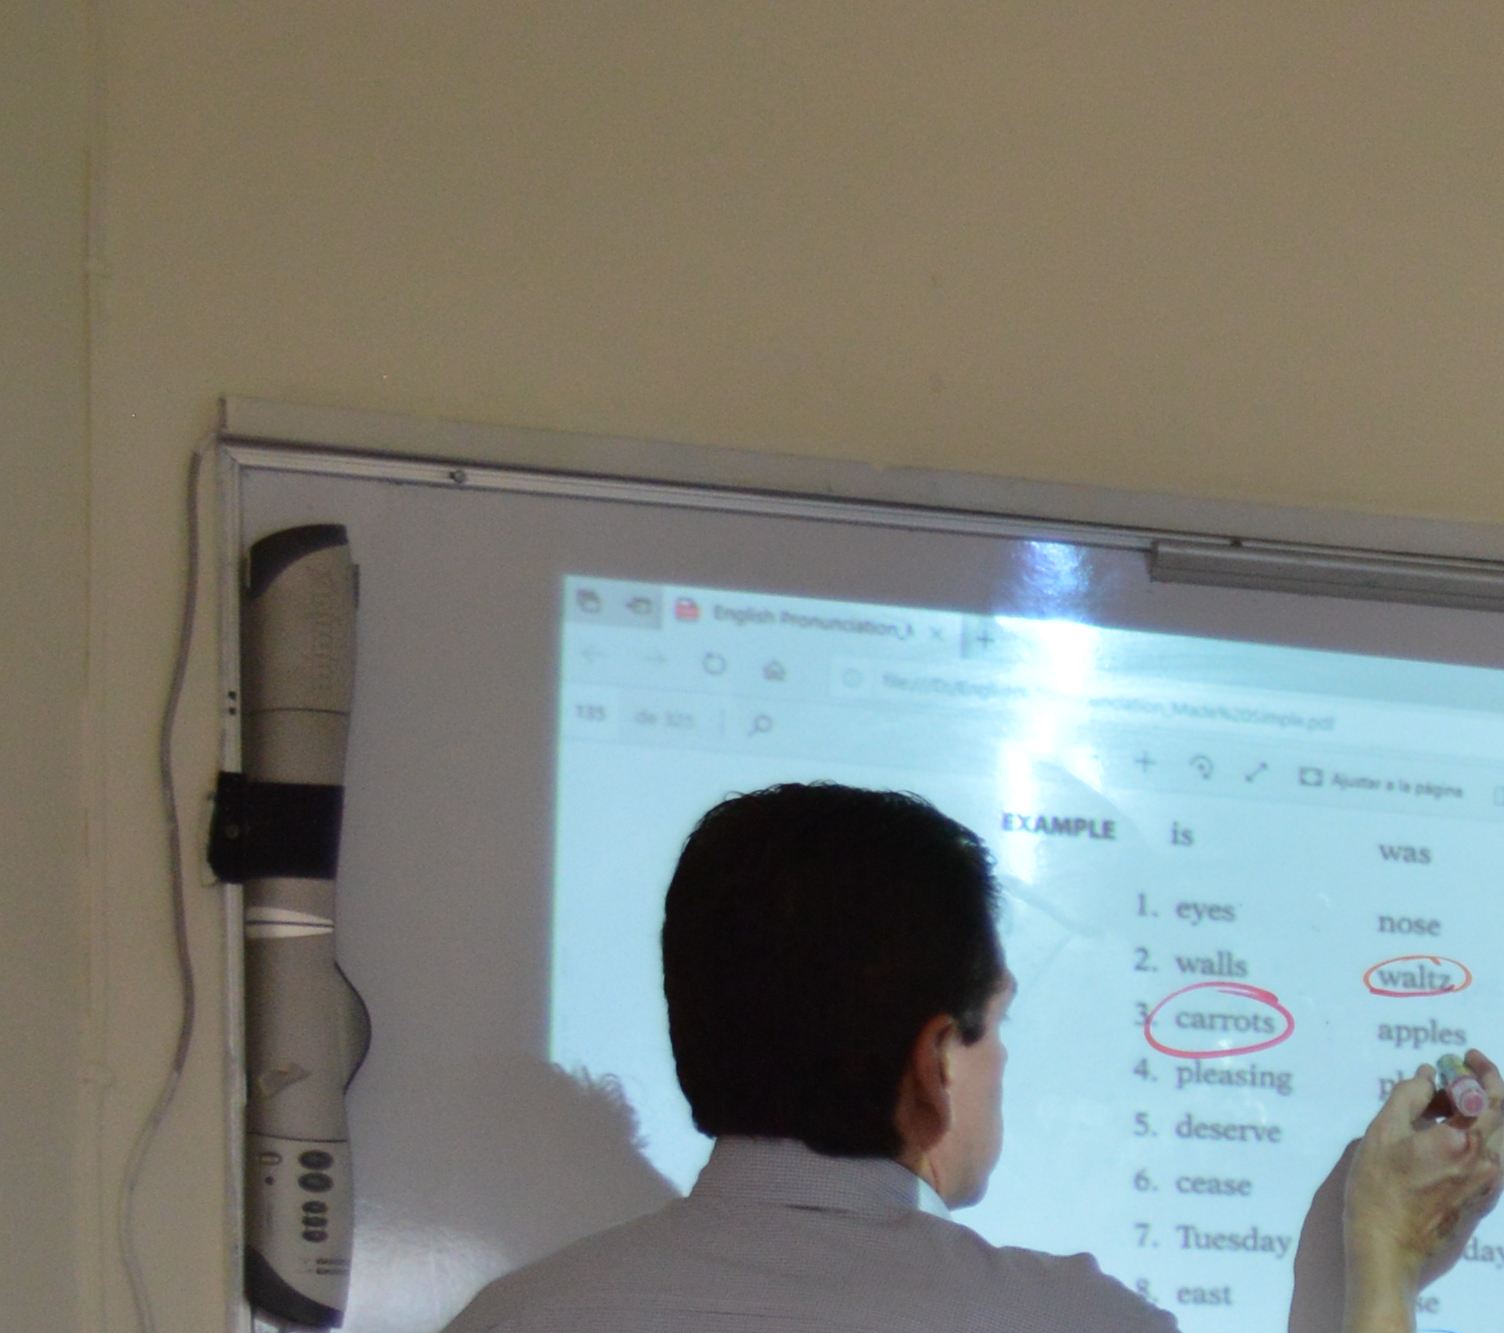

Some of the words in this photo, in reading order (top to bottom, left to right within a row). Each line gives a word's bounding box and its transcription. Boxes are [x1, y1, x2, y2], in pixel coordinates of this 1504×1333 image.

[713, 603, 776, 627] English
[1331, 773, 1380, 792] Ajustar
[1415, 783, 1464, 800] página
[1001, 812, 1117, 840] EXAMPLE
[1170, 821, 1195, 846] is
[1378, 843, 1432, 865] was
[1136, 892, 1159, 918] 1.
[1175, 899, 1237, 927] eyes
[1378, 914, 1442, 937] nose
[1134, 948, 1159, 973] 2.
[1175, 951, 1249, 978] walls
[1377, 963, 1452, 991] waltz
[1175, 1009, 1276, 1034] carrots
[1377, 1018, 1468, 1049] apples
[1133, 1058, 1158, 1082] 4.
[1175, 1060, 1294, 1097] pleasing
[1134, 1113, 1158, 1138] 5.
[1174, 1115, 1282, 1143] deserve
[1134, 1170, 1159, 1193] 6.
[1174, 1173, 1253, 1196] cease
[1134, 1224, 1159, 1249] 7.
[1175, 1224, 1294, 1259] Tuesday
[1176, 1285, 1233, 1306] east
